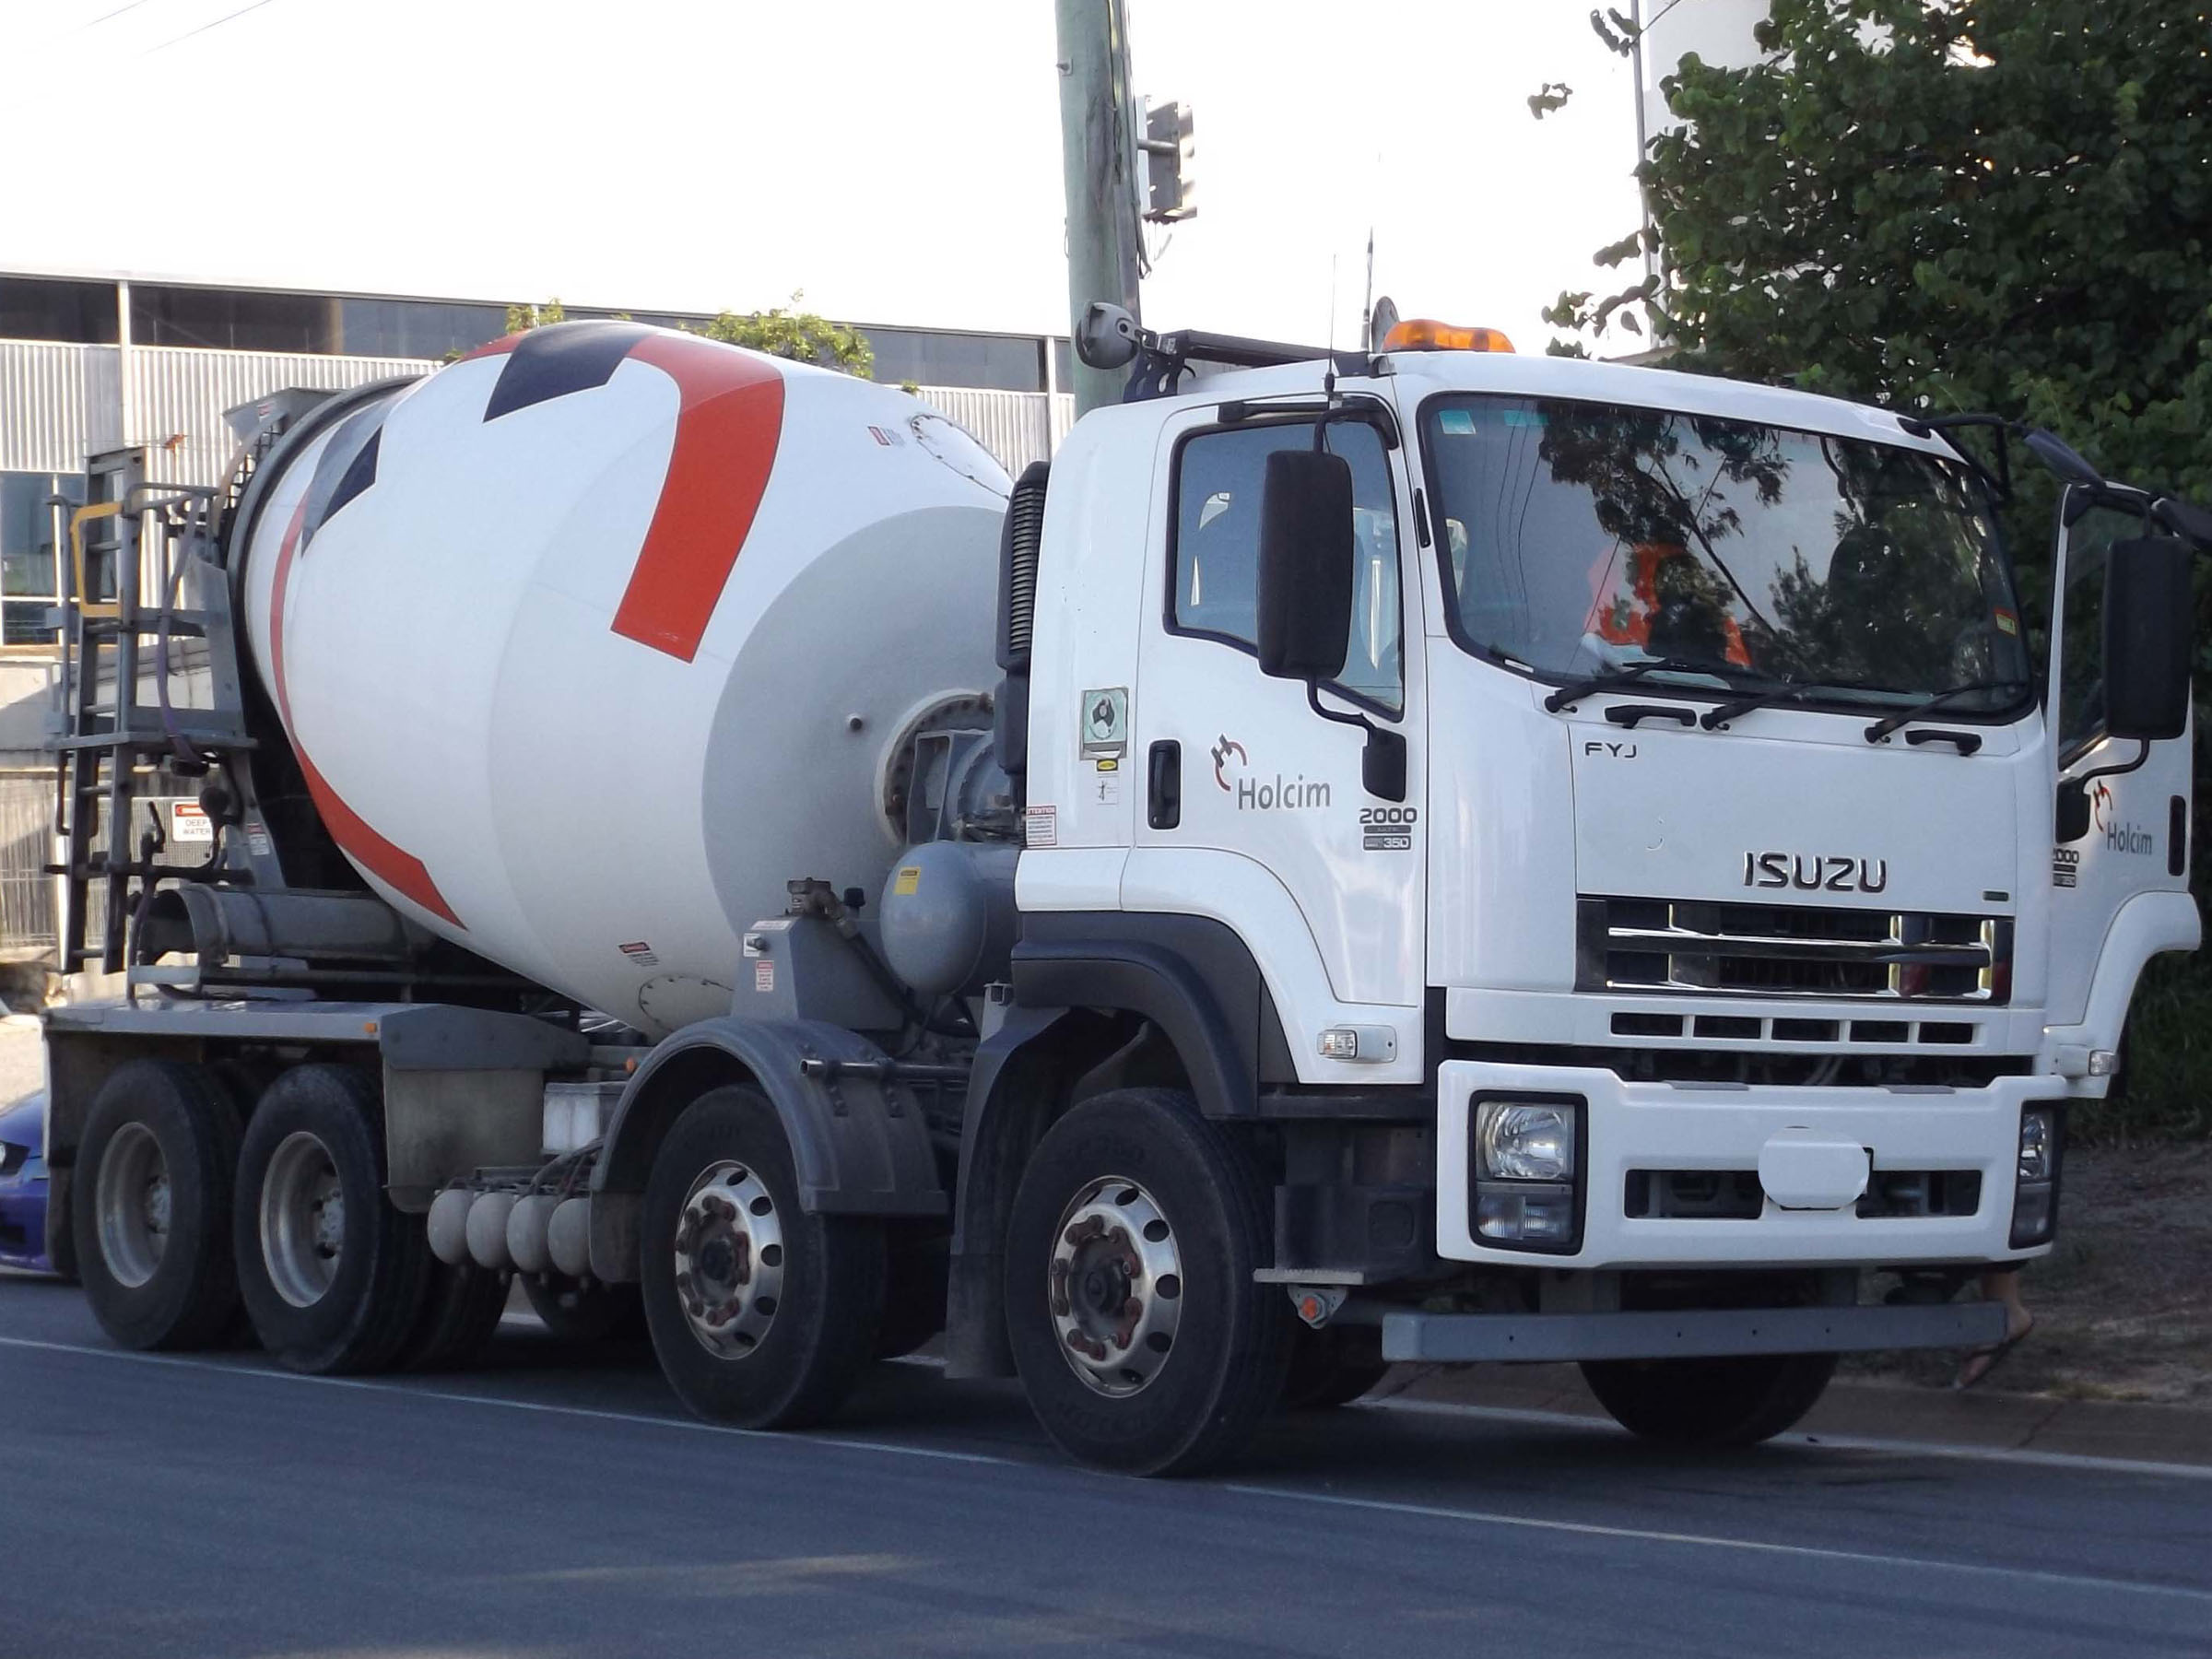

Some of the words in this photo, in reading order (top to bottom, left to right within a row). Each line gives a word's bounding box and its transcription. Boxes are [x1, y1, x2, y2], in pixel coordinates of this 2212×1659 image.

[1585, 741, 1637, 759] FYJ
[1238, 773, 1331, 810] Holcim
[185, 818, 209, 827] DEEP
[1359, 807, 1418, 824] 2000
[2107, 821, 2153, 855] Holcim
[1744, 852, 1888, 893] ISUZU
